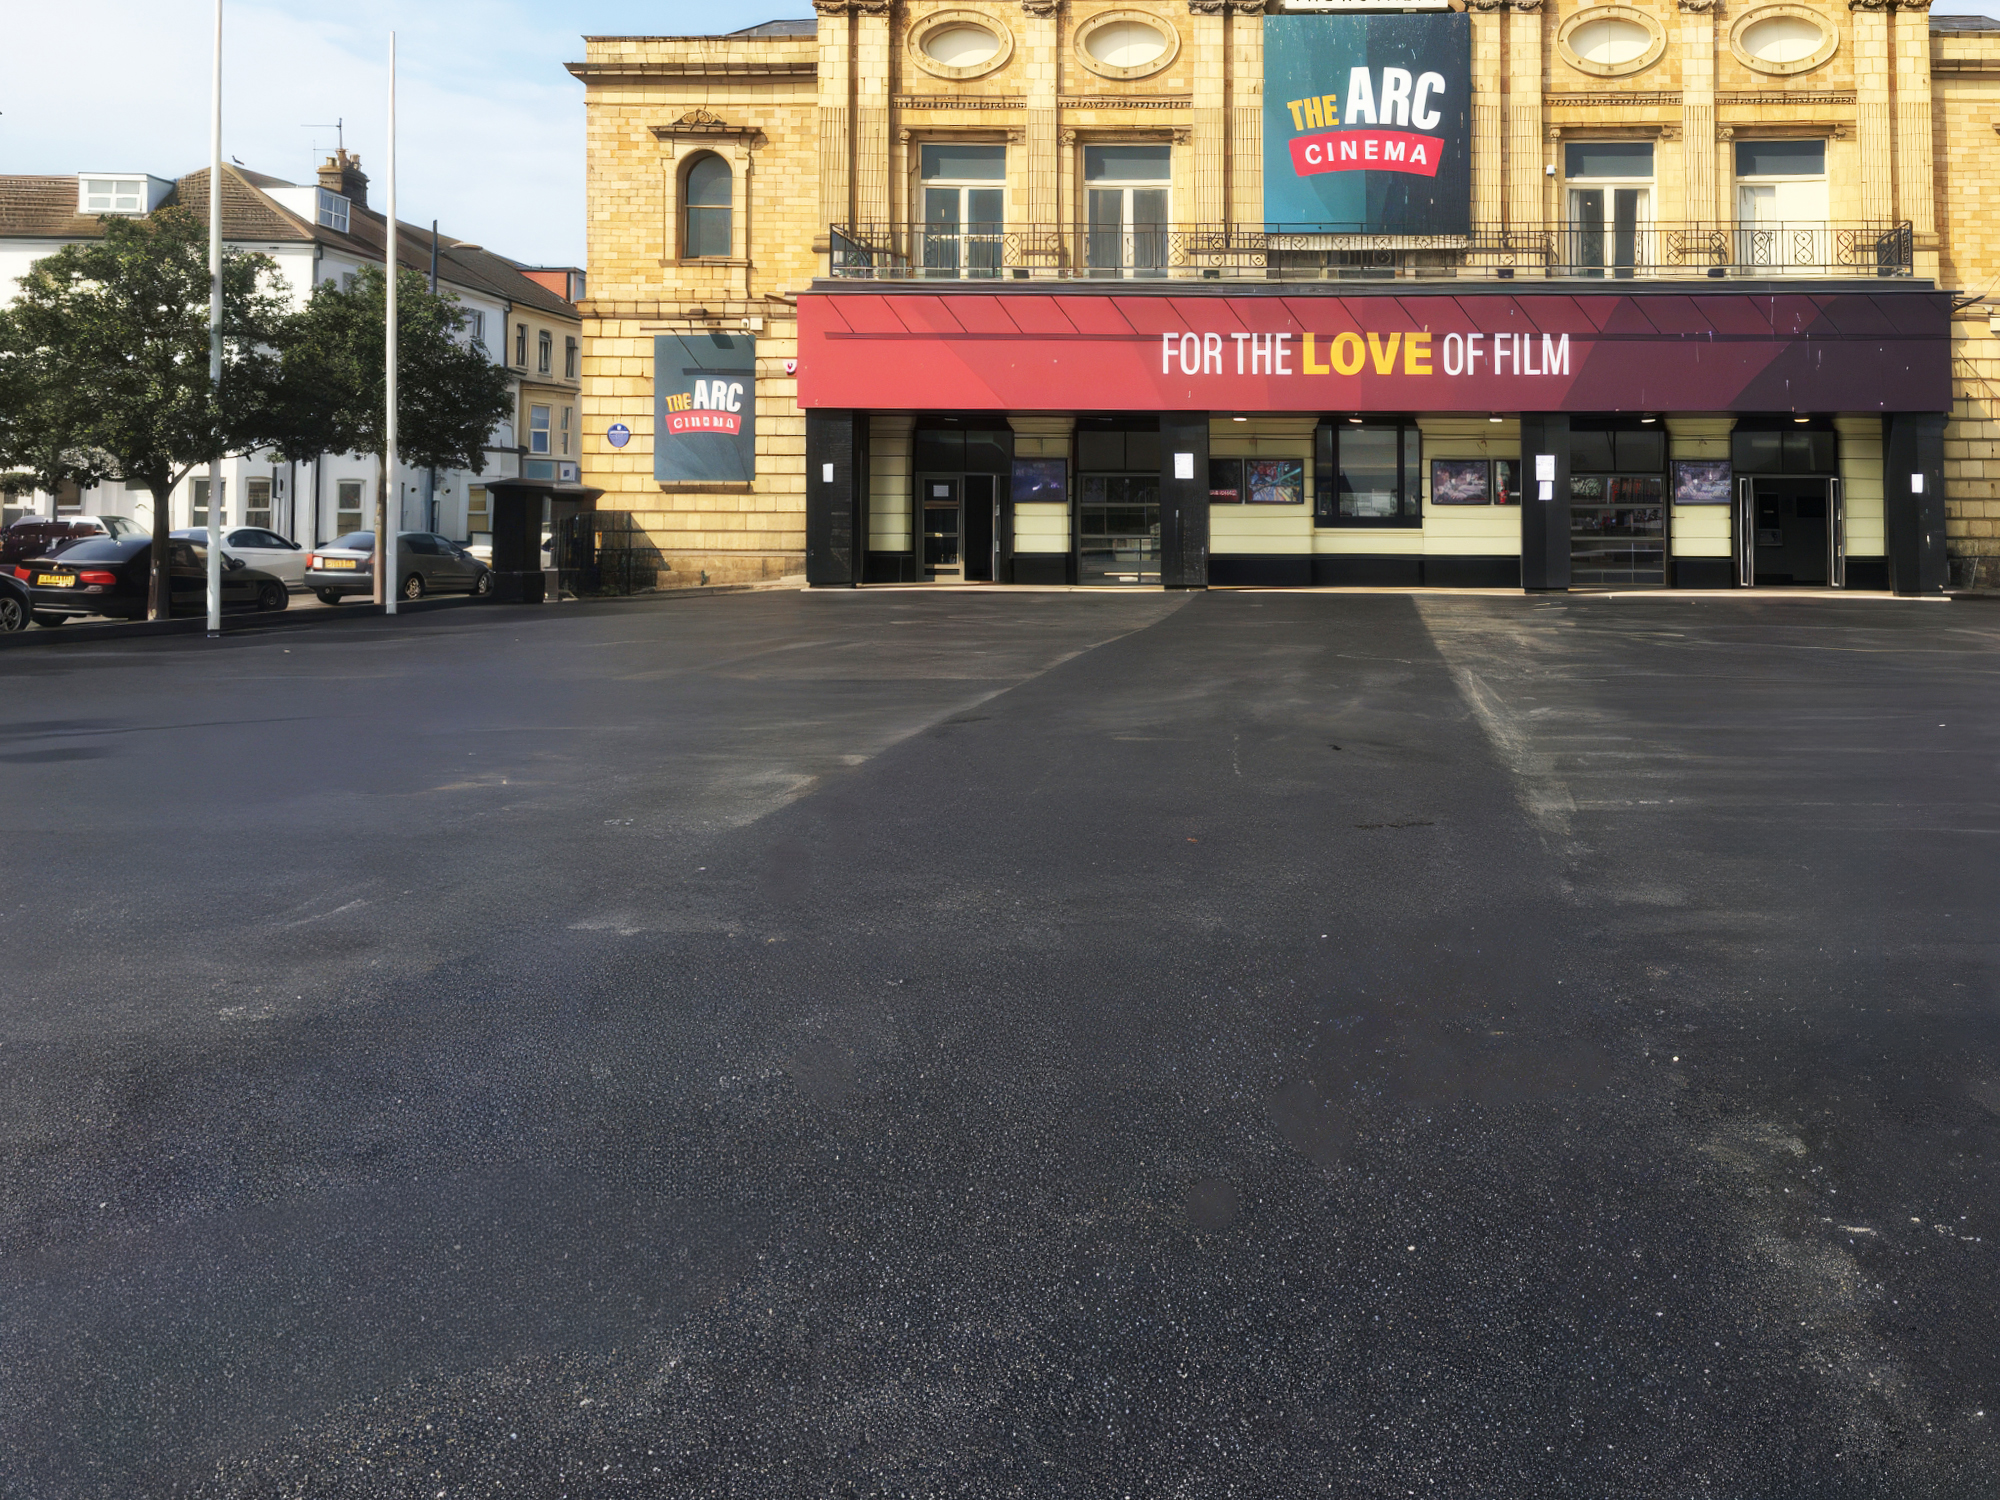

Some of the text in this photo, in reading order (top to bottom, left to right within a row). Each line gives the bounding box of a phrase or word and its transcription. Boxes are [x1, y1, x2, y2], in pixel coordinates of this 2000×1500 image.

[1286, 66, 1446, 131] THE ARC
[1304, 139, 1428, 165] CINEMA
[1162, 332, 1570, 376] FOR THE LOVE OF FILM
[665, 379, 744, 412] THE ARC
